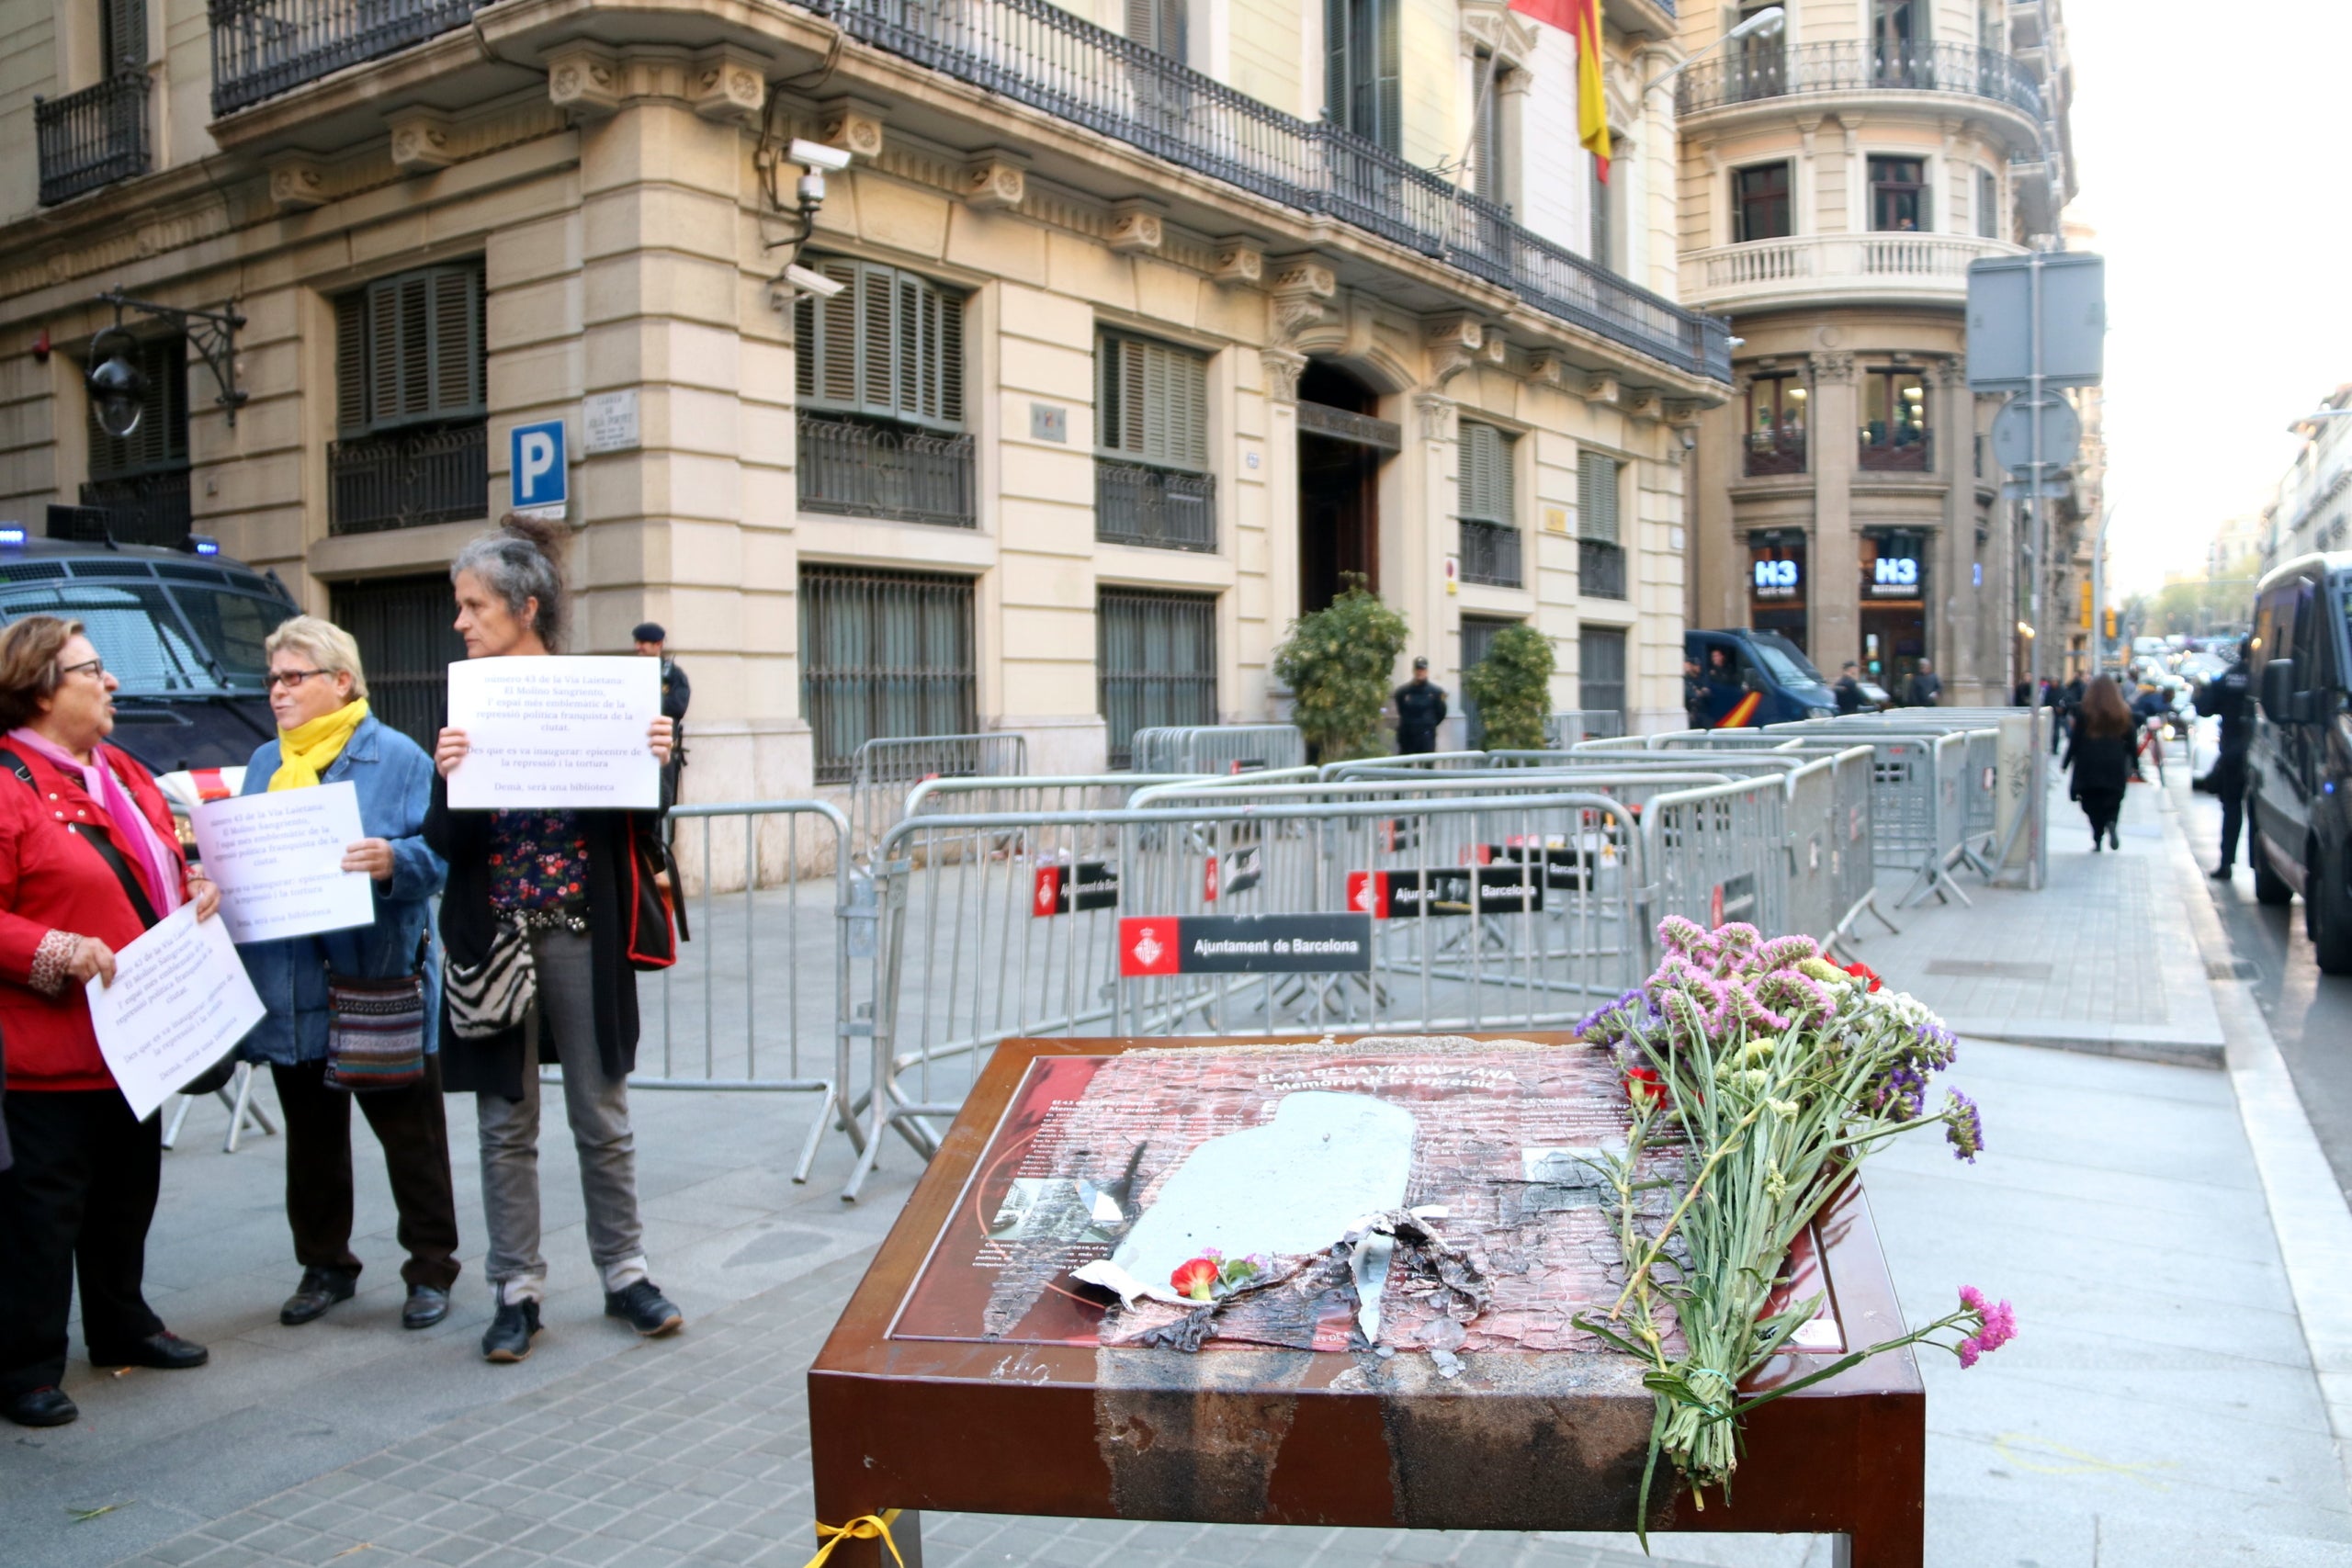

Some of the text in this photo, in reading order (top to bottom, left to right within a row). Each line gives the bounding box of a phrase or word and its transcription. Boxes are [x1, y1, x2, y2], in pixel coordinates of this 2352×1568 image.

[521, 432, 554, 498] P
[1755, 559, 1798, 586] H3
[1875, 558, 1917, 584] H3
[524, 675, 537, 683] 43
[538, 674, 550, 683] de
[553, 675, 562, 683] la
[564, 675, 581, 683] Via
[582, 675, 625, 685] Laietana:
[504, 685, 607, 698] El Molino Sangriento,
[496, 698, 521, 709] espai
[524, 699, 543, 707] més
[546, 699, 600, 708] emblemàtic
[603, 700, 615, 708] de
[616, 700, 626, 708] la
[476, 709, 521, 720] repressió
[560, 711, 608, 723] franquista
[610, 711, 623, 720] de
[625, 712, 633, 721] la
[486, 748, 504, 757] que
[520, 748, 531, 756] va
[533, 747, 582, 758] inaugurar:
[585, 747, 628, 759] epicentre
[630, 748, 642, 757] de
[501, 758, 511, 767] la
[513, 758, 557, 769] repressió
[564, 759, 573, 768] la
[575, 760, 608, 768] tortura
[494, 782, 615, 793] Demà, serà una biblioteca
[1550, 863, 1591, 875] Barceloa
[1481, 884, 1537, 897] Barceloa
[1193, 938, 1360, 958] Ajuntament de Barcelona
